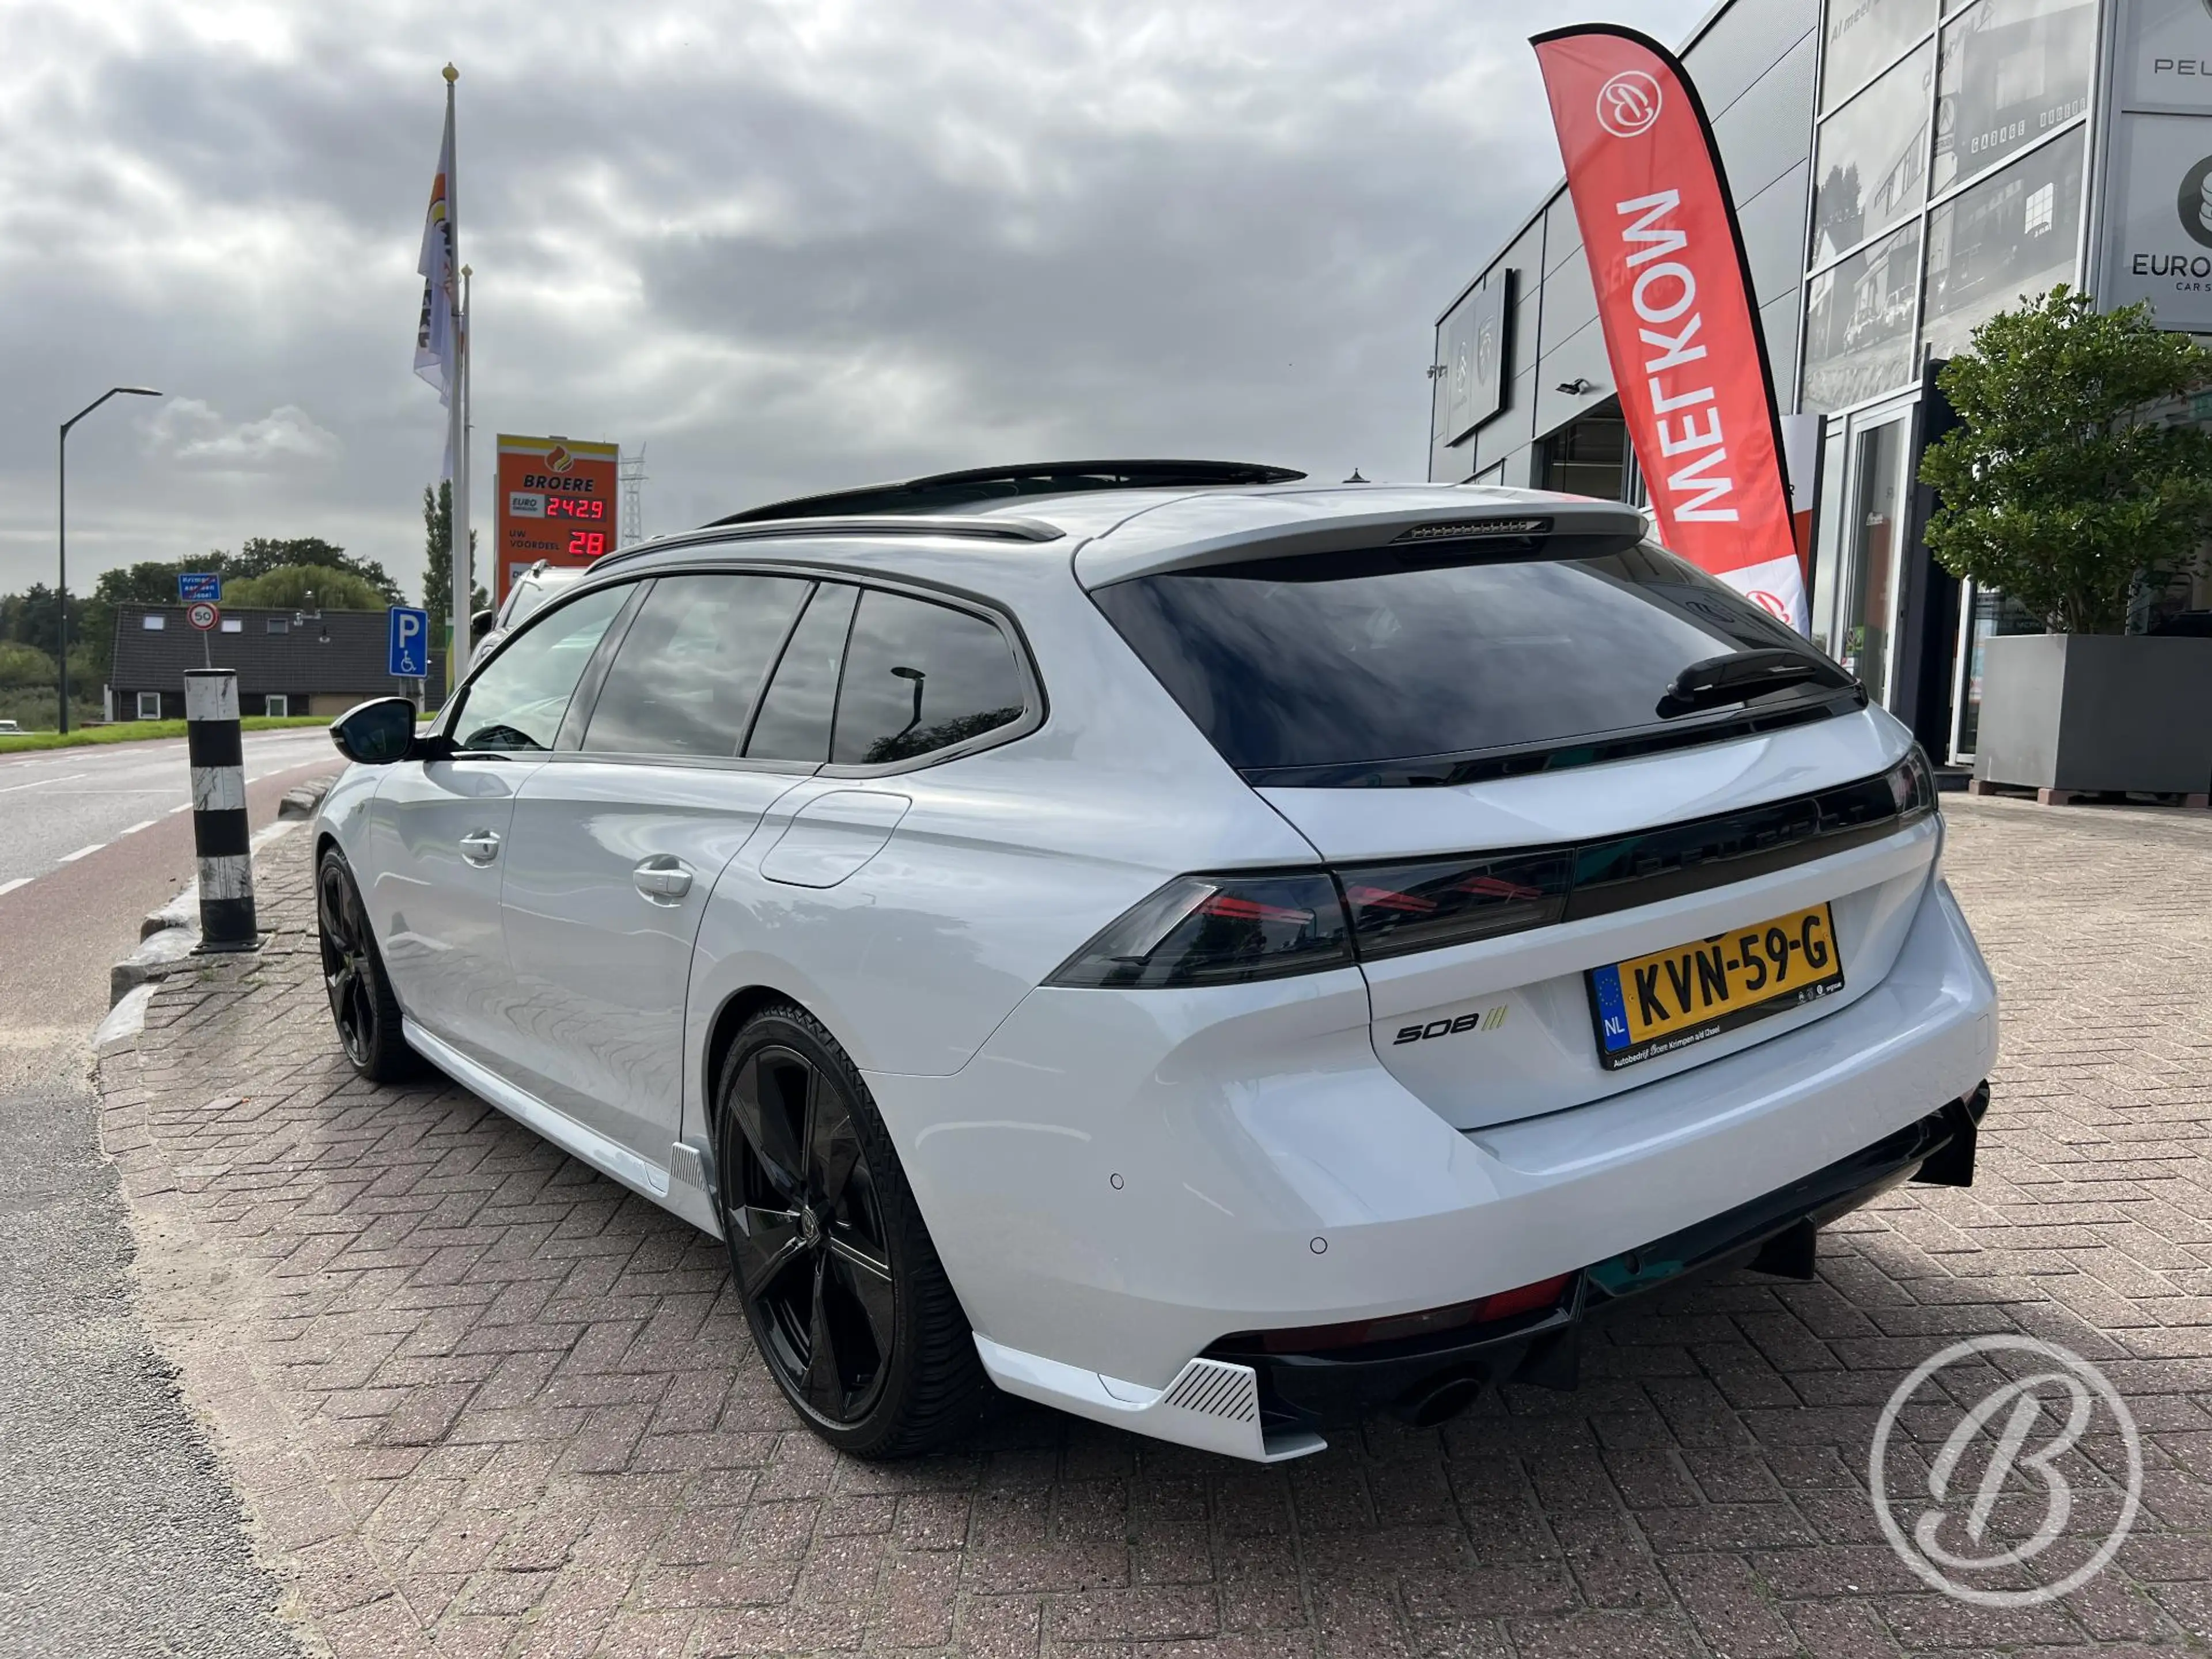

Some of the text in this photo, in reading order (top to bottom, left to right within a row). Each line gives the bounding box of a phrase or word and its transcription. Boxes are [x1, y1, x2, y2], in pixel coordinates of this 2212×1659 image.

[2133, 253, 2211, 278] EURO
[2176, 282, 2200, 291] CAR
[523, 475, 594, 492] BROERE
[512, 497, 604, 518] EURO 2429
[569, 531, 604, 555] 28
[195, 611, 211, 621] 50
[399, 613, 420, 648] P
[1634, 915, 1828, 1027] KVN-59-G
[1393, 1013, 1479, 1045] 508
[1604, 1016, 1626, 1037] NL
[1613, 1048, 1649, 1068] Autobedrijf
